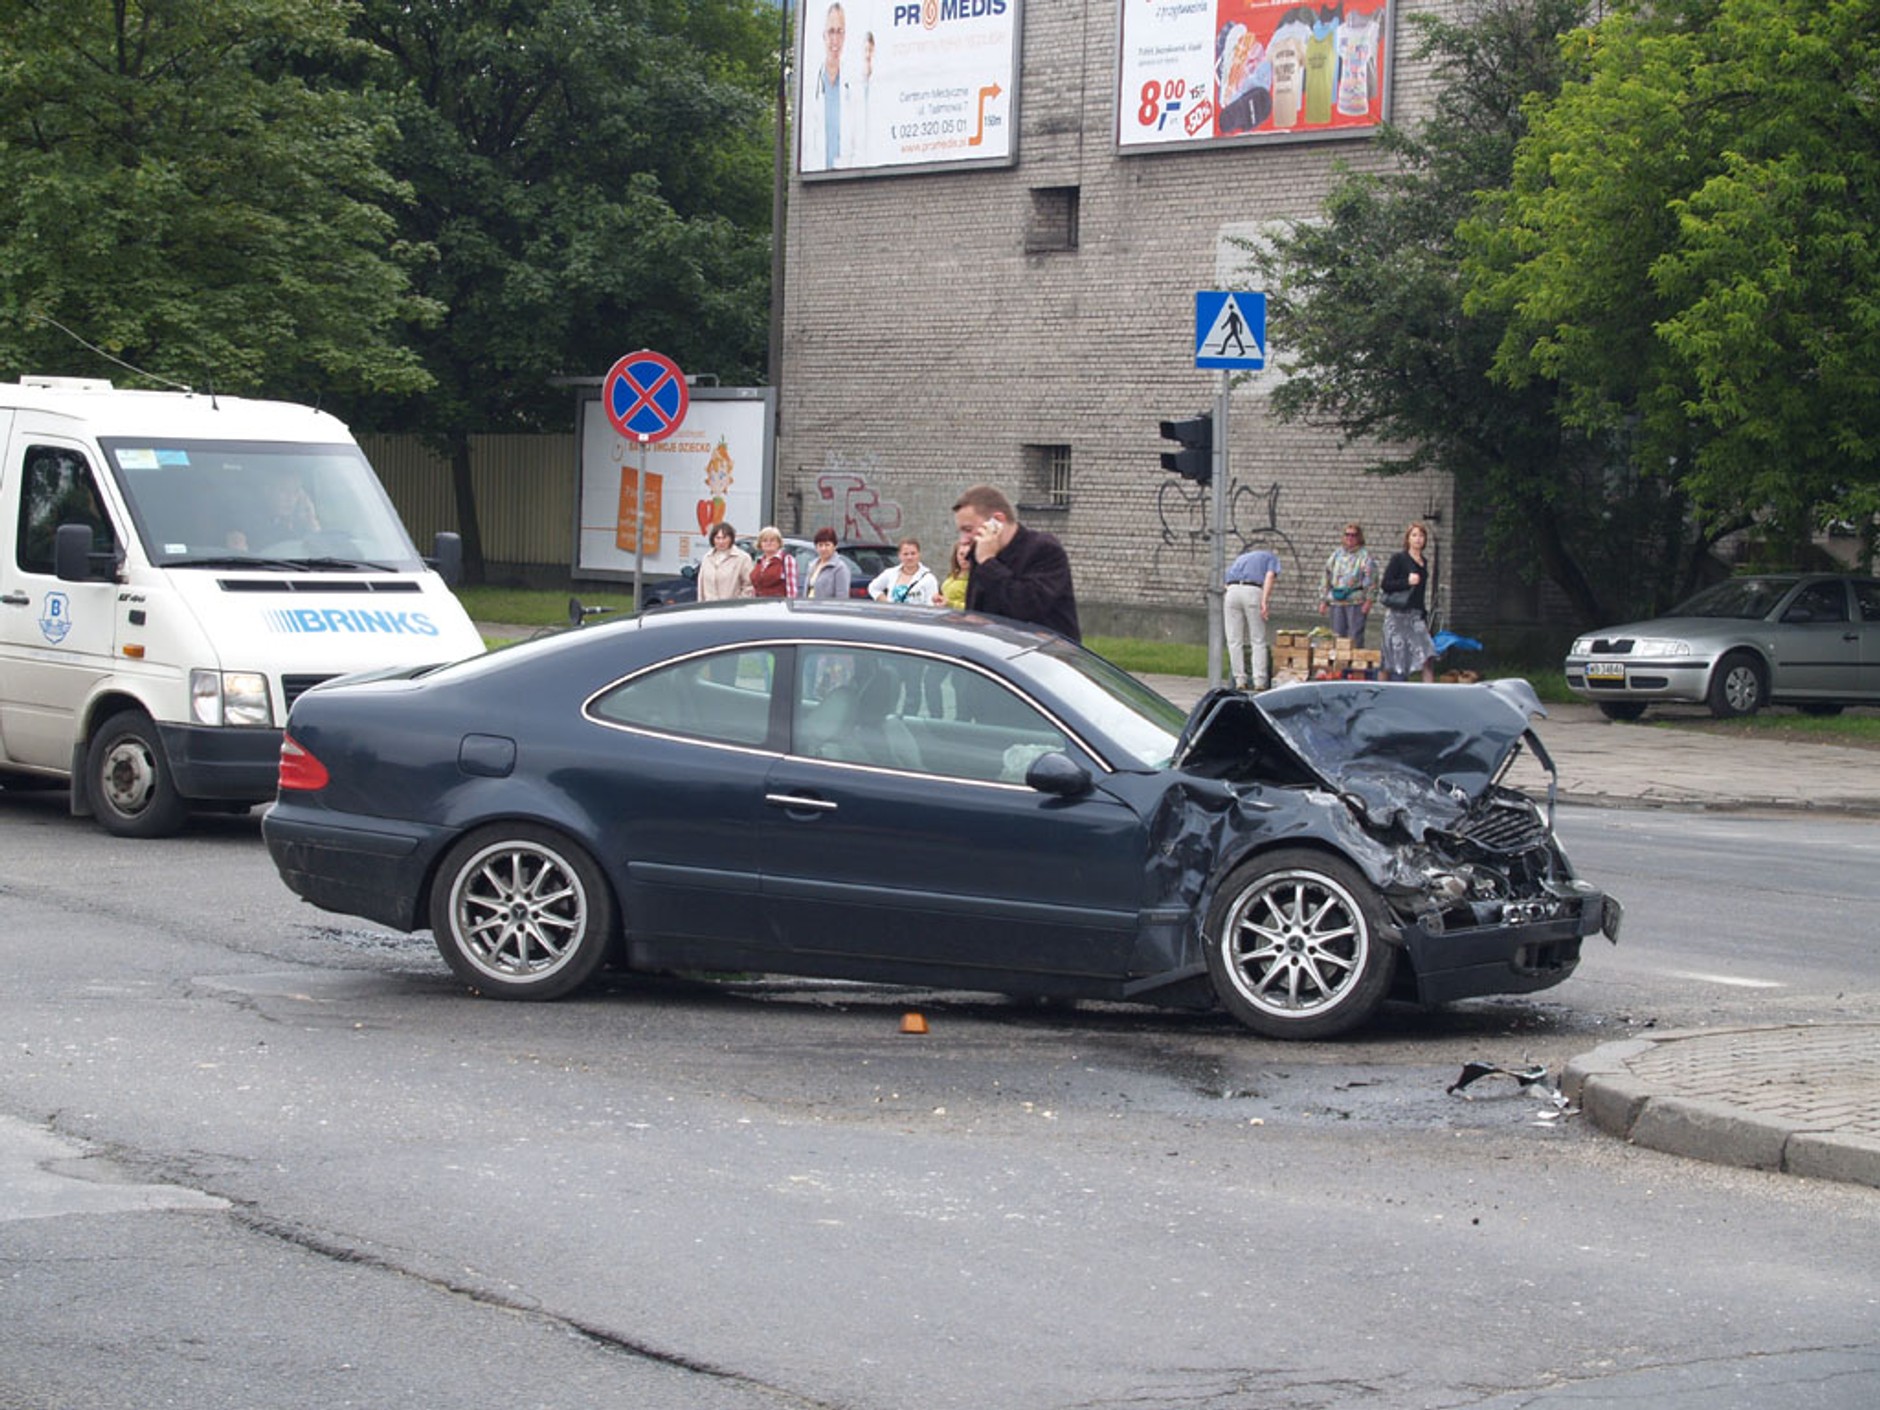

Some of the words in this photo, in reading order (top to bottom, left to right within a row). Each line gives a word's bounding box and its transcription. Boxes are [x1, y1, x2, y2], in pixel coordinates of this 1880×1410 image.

[899, 124, 919, 139] 022
[921, 121, 939, 136] 320
[51, 599, 62, 617] B
[294, 608, 440, 637] BRINKS
